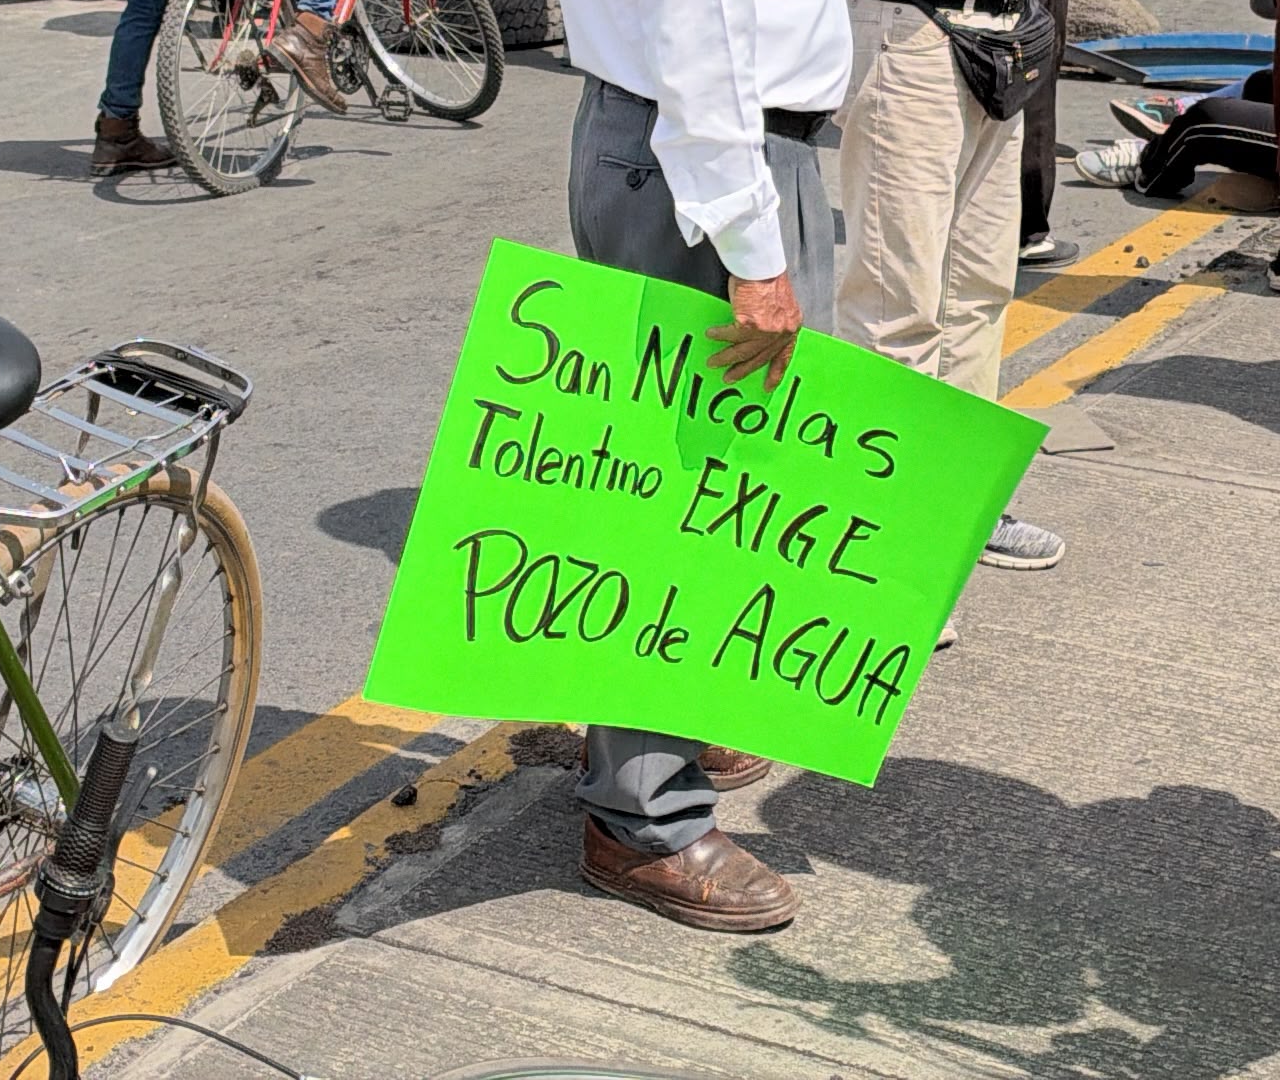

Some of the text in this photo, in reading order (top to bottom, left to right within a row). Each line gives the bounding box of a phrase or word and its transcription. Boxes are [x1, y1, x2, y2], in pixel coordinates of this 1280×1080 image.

[496, 279, 899, 479] San Nicolas
[468, 399, 881, 584] Tolentino EXIGE
[453, 529, 910, 725] POZO de AGUA
